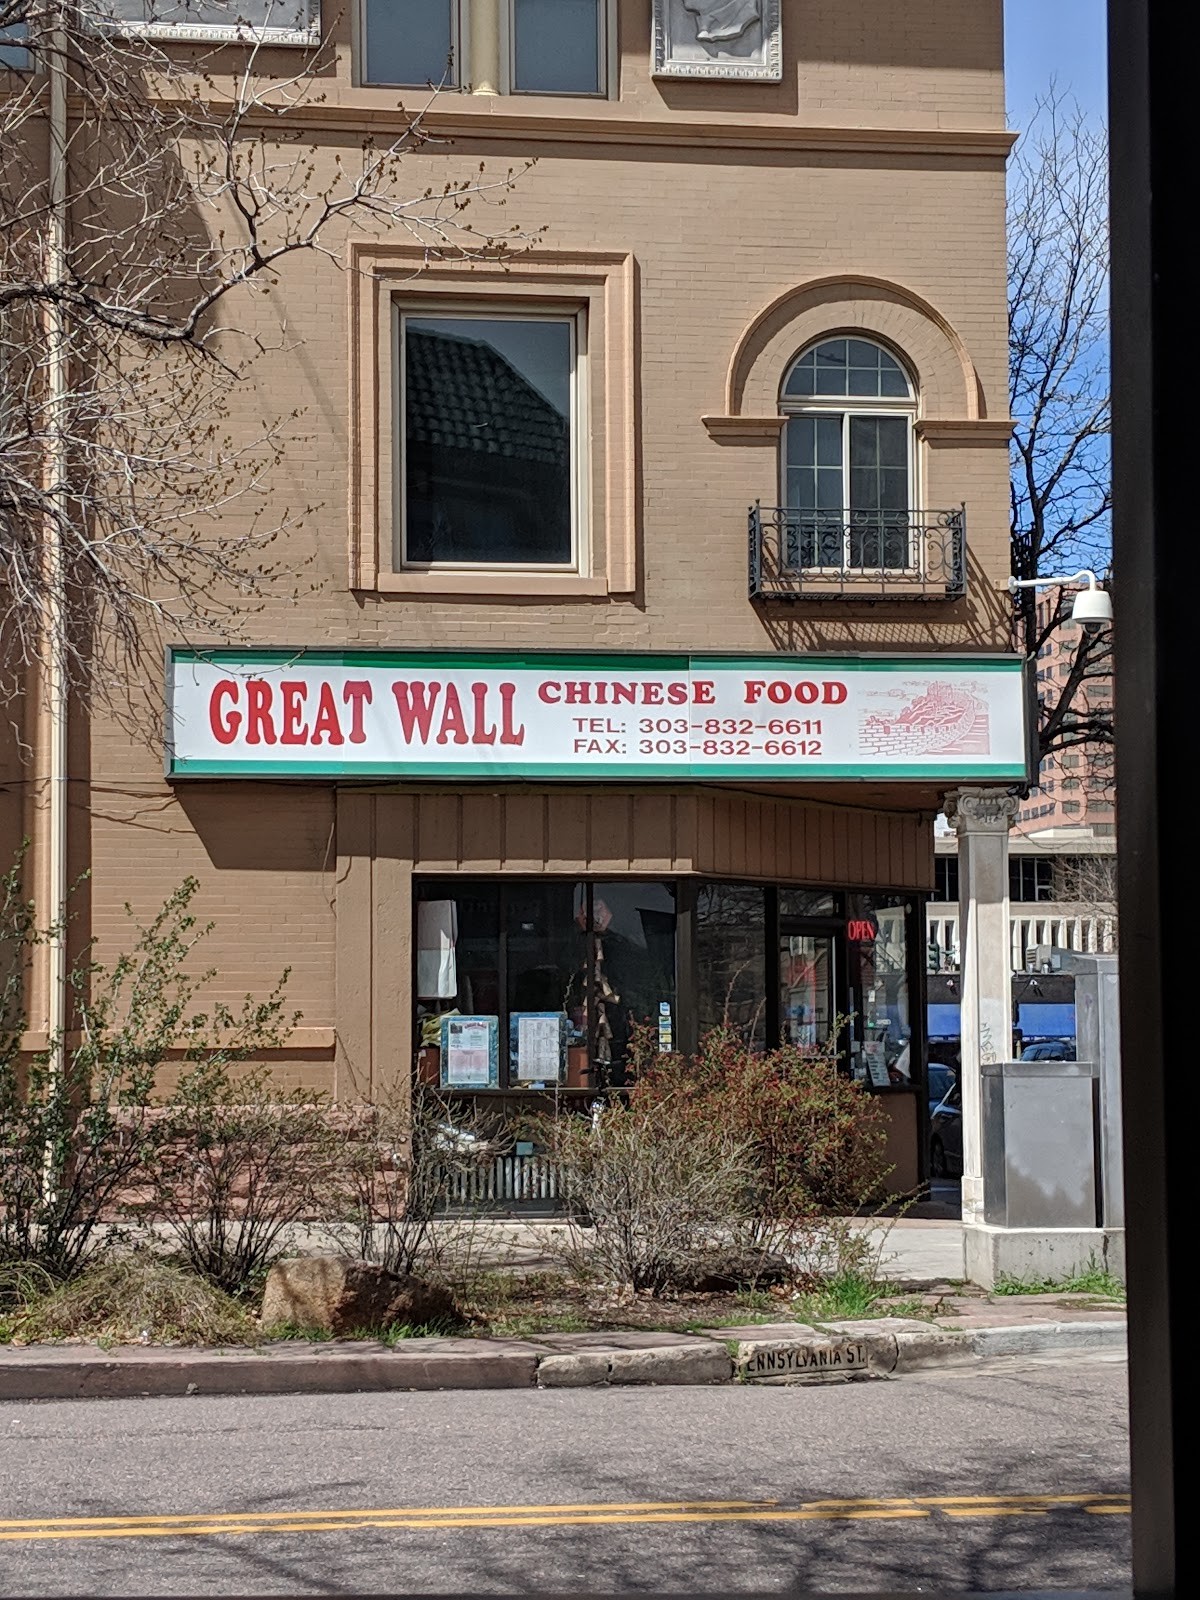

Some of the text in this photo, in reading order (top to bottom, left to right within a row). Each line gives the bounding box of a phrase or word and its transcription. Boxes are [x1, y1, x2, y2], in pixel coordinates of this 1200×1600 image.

[537, 680, 848, 705] CHINESE FOOD
[208, 679, 526, 747] GREAT WALL
[572, 717, 823, 735] TEL: 303-832-6611
[573, 738, 823, 756] FAX: 303-832-6612
[847, 920, 875, 941] OPEN
